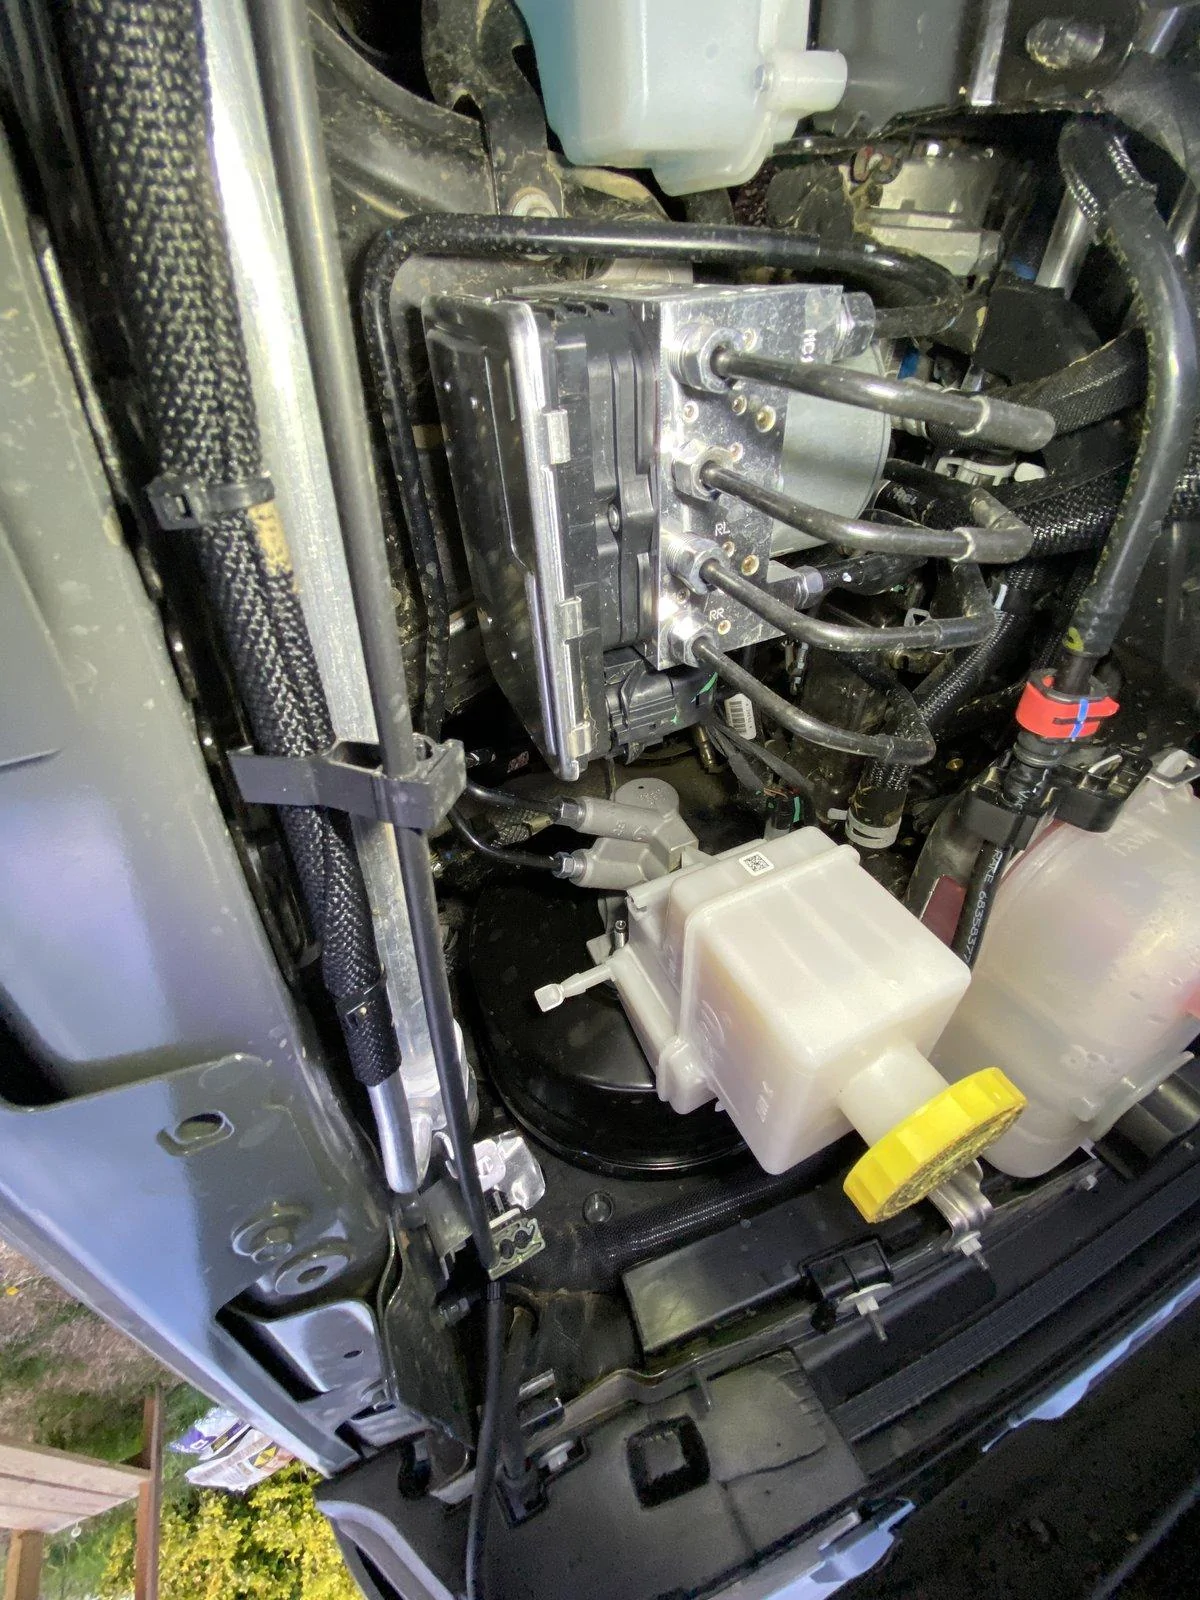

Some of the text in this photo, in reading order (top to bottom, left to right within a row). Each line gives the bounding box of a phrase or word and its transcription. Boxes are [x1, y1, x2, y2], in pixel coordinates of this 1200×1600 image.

[714, 520, 731, 537] RL
[709, 607, 725, 621] RR
[983, 848, 1003, 883] RAKE
[963, 890, 988, 964] 68358377
